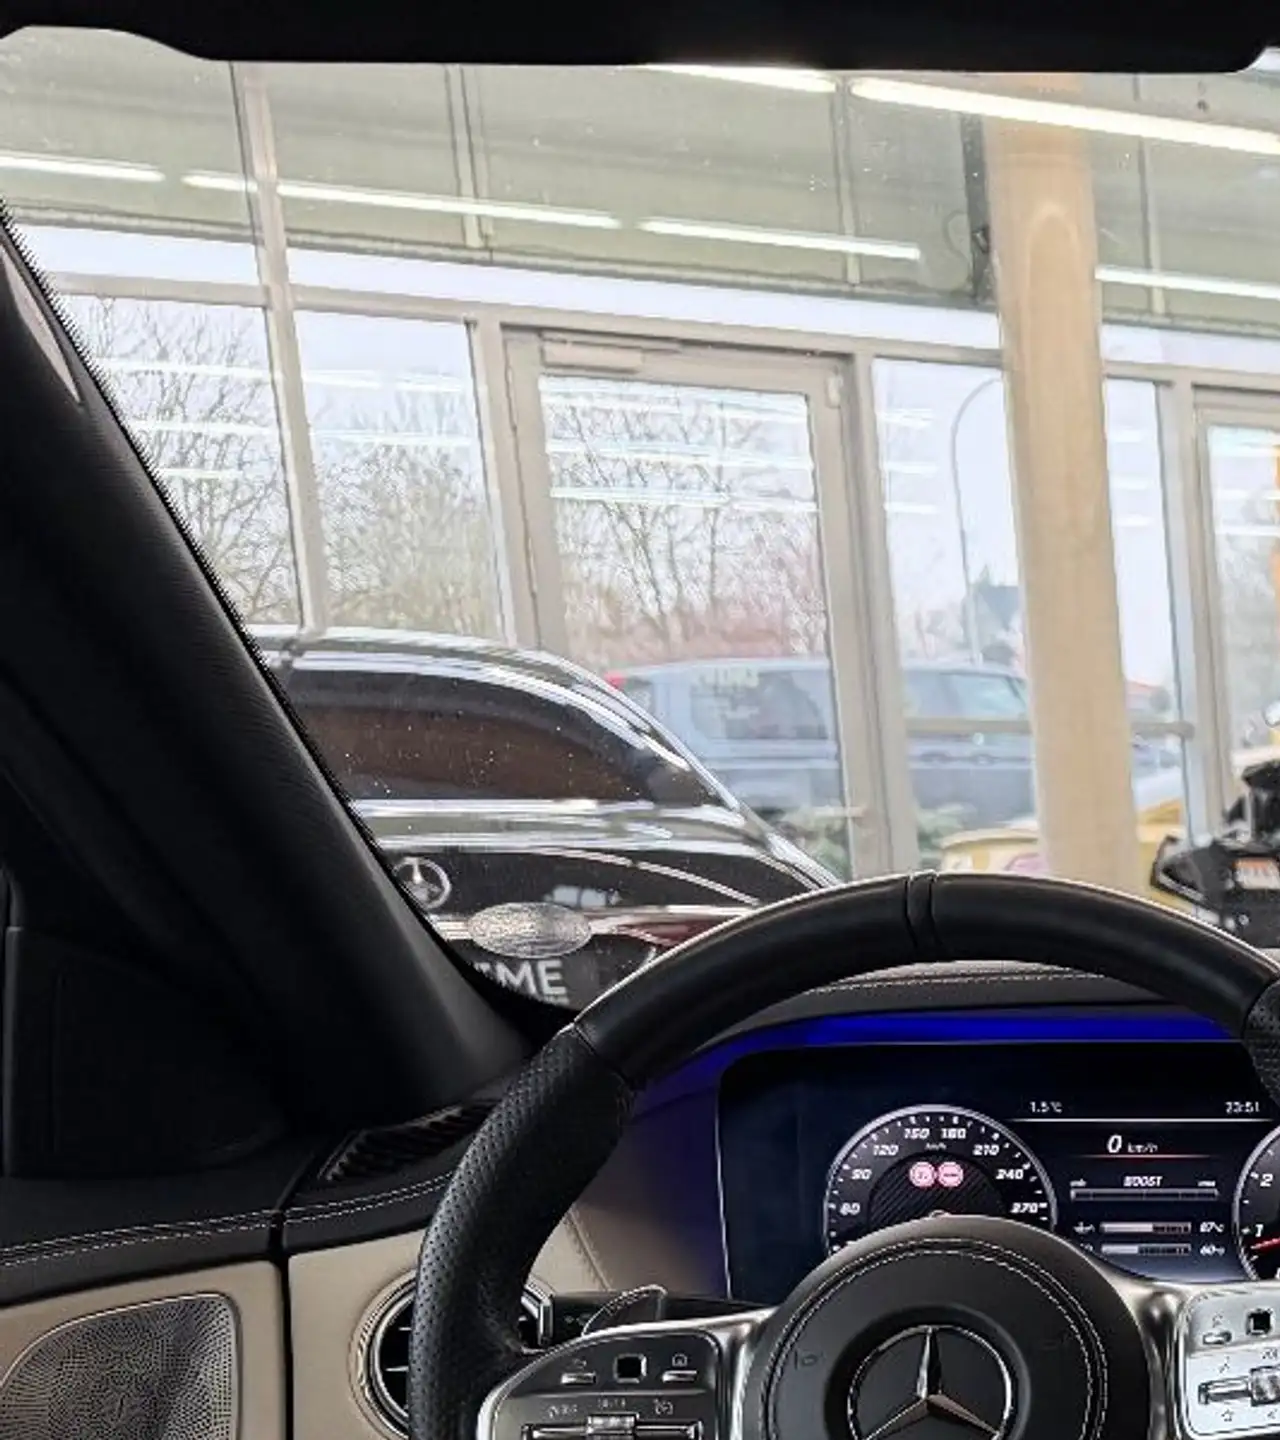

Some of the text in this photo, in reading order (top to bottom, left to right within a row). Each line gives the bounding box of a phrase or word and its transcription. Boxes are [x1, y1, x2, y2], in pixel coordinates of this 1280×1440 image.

[1225, 1102, 1260, 1113] 23:51
[904, 1128, 930, 1139] 150
[1107, 1135, 1122, 1153] 0
[872, 1145, 899, 1156] 120
[973, 1145, 1000, 1156] 210
[852, 1169, 872, 1180] 90
[996, 1169, 1024, 1180] 240
[1123, 1176, 1162, 1187] BOOST
[1260, 1174, 1273, 1187] 2
[1011, 1203, 1038, 1214] 270
